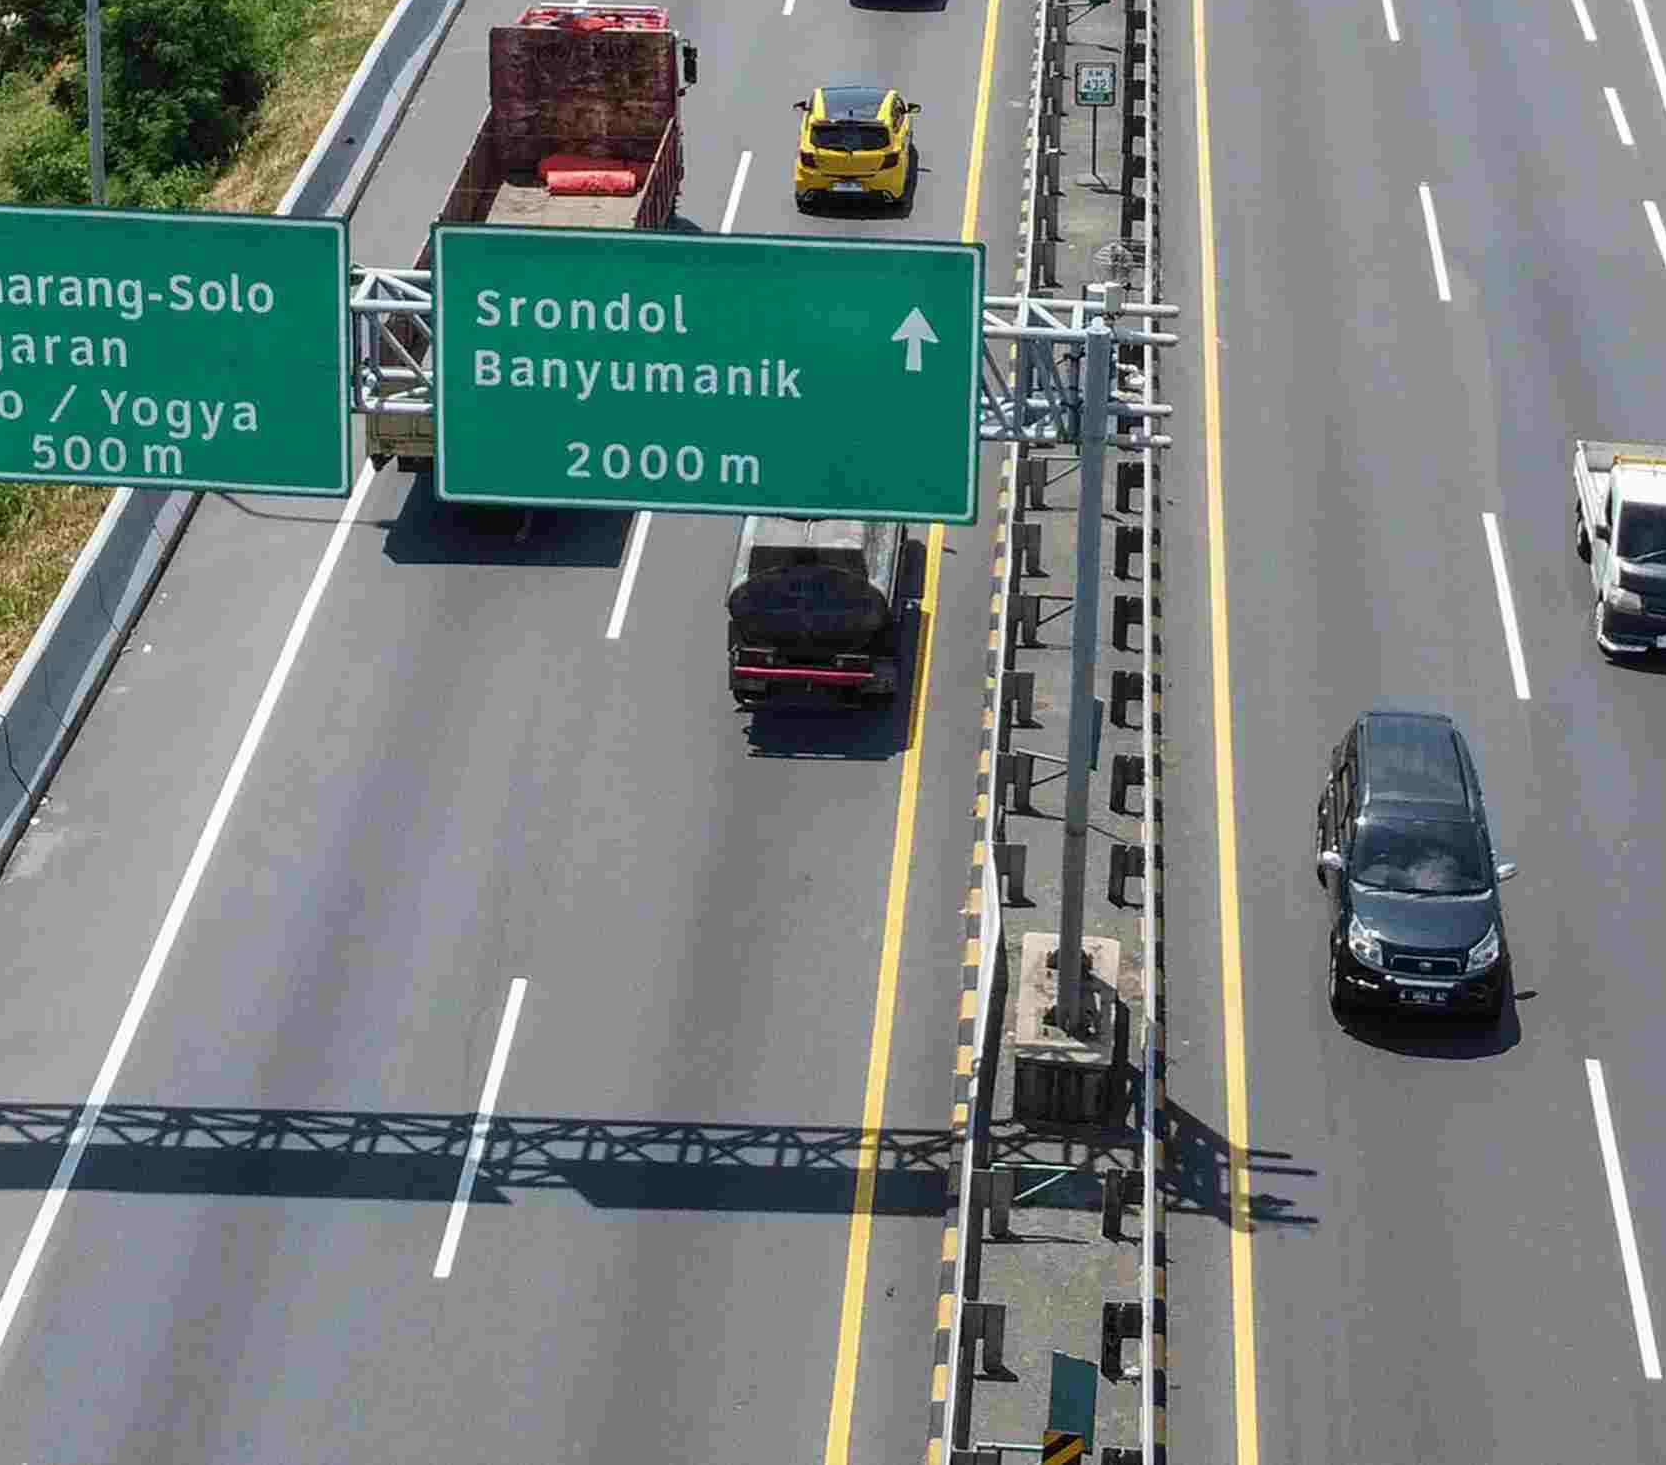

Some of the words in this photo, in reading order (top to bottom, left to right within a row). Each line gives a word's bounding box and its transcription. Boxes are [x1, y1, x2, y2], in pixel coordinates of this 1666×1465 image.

[476, 290, 687, 334] Srondol
[475, 350, 801, 400] Banyumanik
[49, 385, 77, 423] /
[101, 389, 258, 439] Yogya
[33, 435, 126, 472] 500
[143, 444, 182, 473] m
[567, 442, 704, 481] 2000
[720, 454, 759, 484] m
